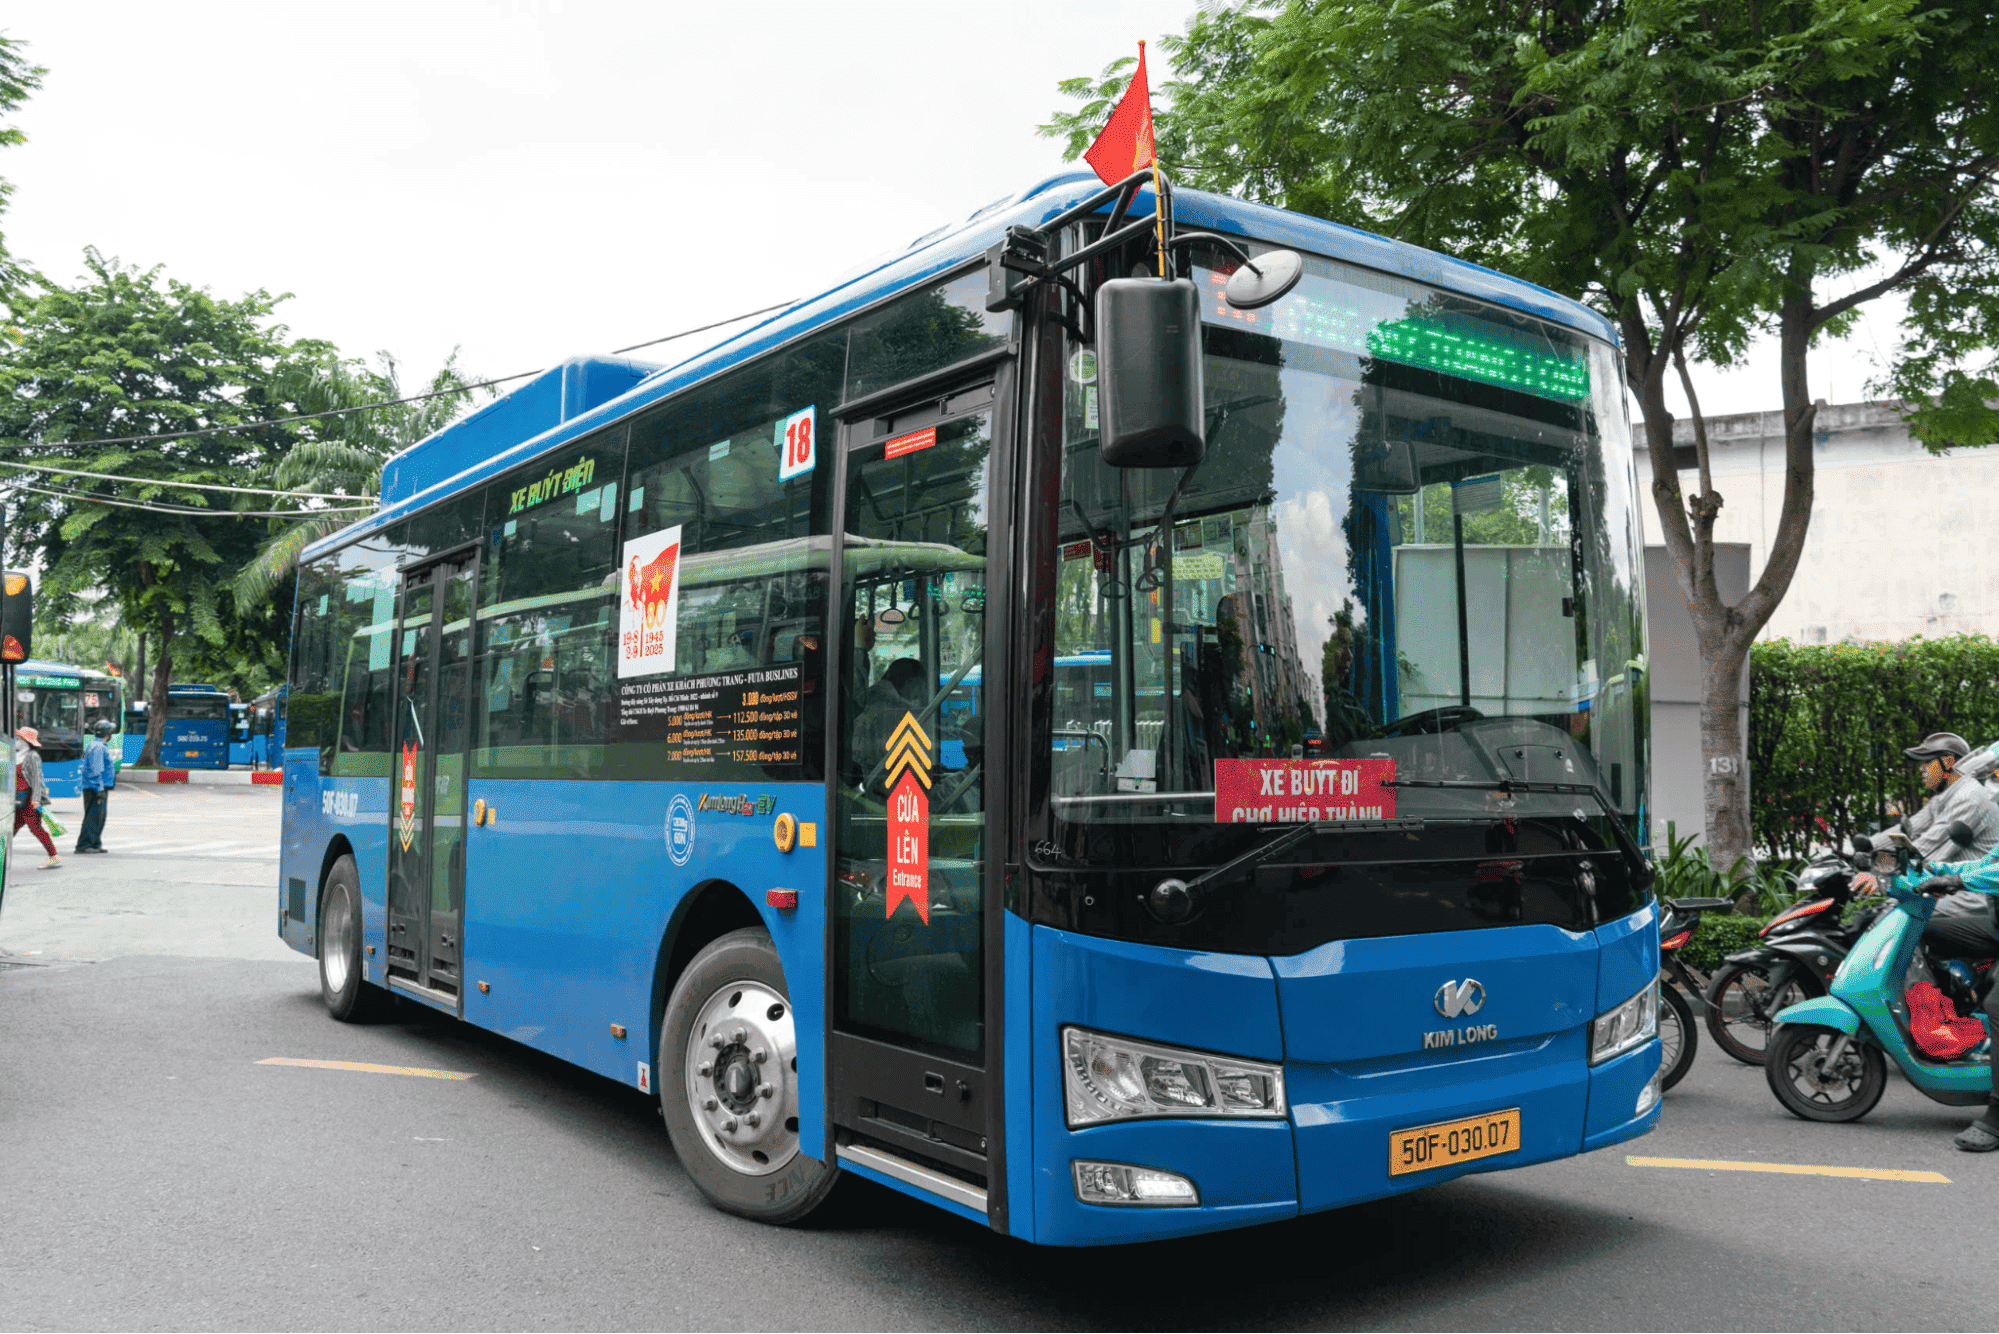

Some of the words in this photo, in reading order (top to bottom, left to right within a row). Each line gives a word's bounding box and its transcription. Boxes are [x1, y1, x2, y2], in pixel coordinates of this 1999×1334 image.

[786, 417, 811, 468] 18
[508, 487, 527, 515] XE
[526, 468, 563, 508] BUÝT
[645, 599, 667, 631] 80
[623, 629, 639, 646] 19-8
[645, 630, 664, 644] 1945
[626, 645, 638, 660] 2-9
[645, 643, 664, 657] 2025
[621, 684, 635, 695] CÔNG
[636, 685, 643, 694] TY
[643, 682, 651, 693] CỔ
[652, 680, 666, 693] PHẦN
[666, 681, 675, 692] XE
[675, 678, 695, 690] KHÁCH
[696, 676, 721, 690] PHƯƠNG
[722, 674, 744, 687] TRANG
[748, 672, 764, 683] FUTA
[765, 668, 798, 682] BUSLINES
[733, 711, 758, 724] 112.500
[783, 711, 790, 720] 30
[790, 711, 798, 719] vé
[733, 729, 758, 742] 135.000
[783, 729, 790, 738] 30
[790, 728, 797, 738] vé
[732, 750, 758, 762] 157.500
[783, 750, 790, 760] 30
[790, 750, 797, 759] vé
[1260, 769, 1285, 796] XE
[1291, 763, 1337, 796] BUÝT
[1340, 769, 1359, 796] ĐI
[897, 785, 919, 823] CỬA
[897, 829, 919, 864] LÊN
[1034, 840, 1062, 860] 664
[892, 868, 922, 889] Entrance
[1423, 1029, 1454, 1049] KIM
[1457, 1024, 1498, 1045] LONG
[1402, 1119, 1510, 1165] 50F-030.07
